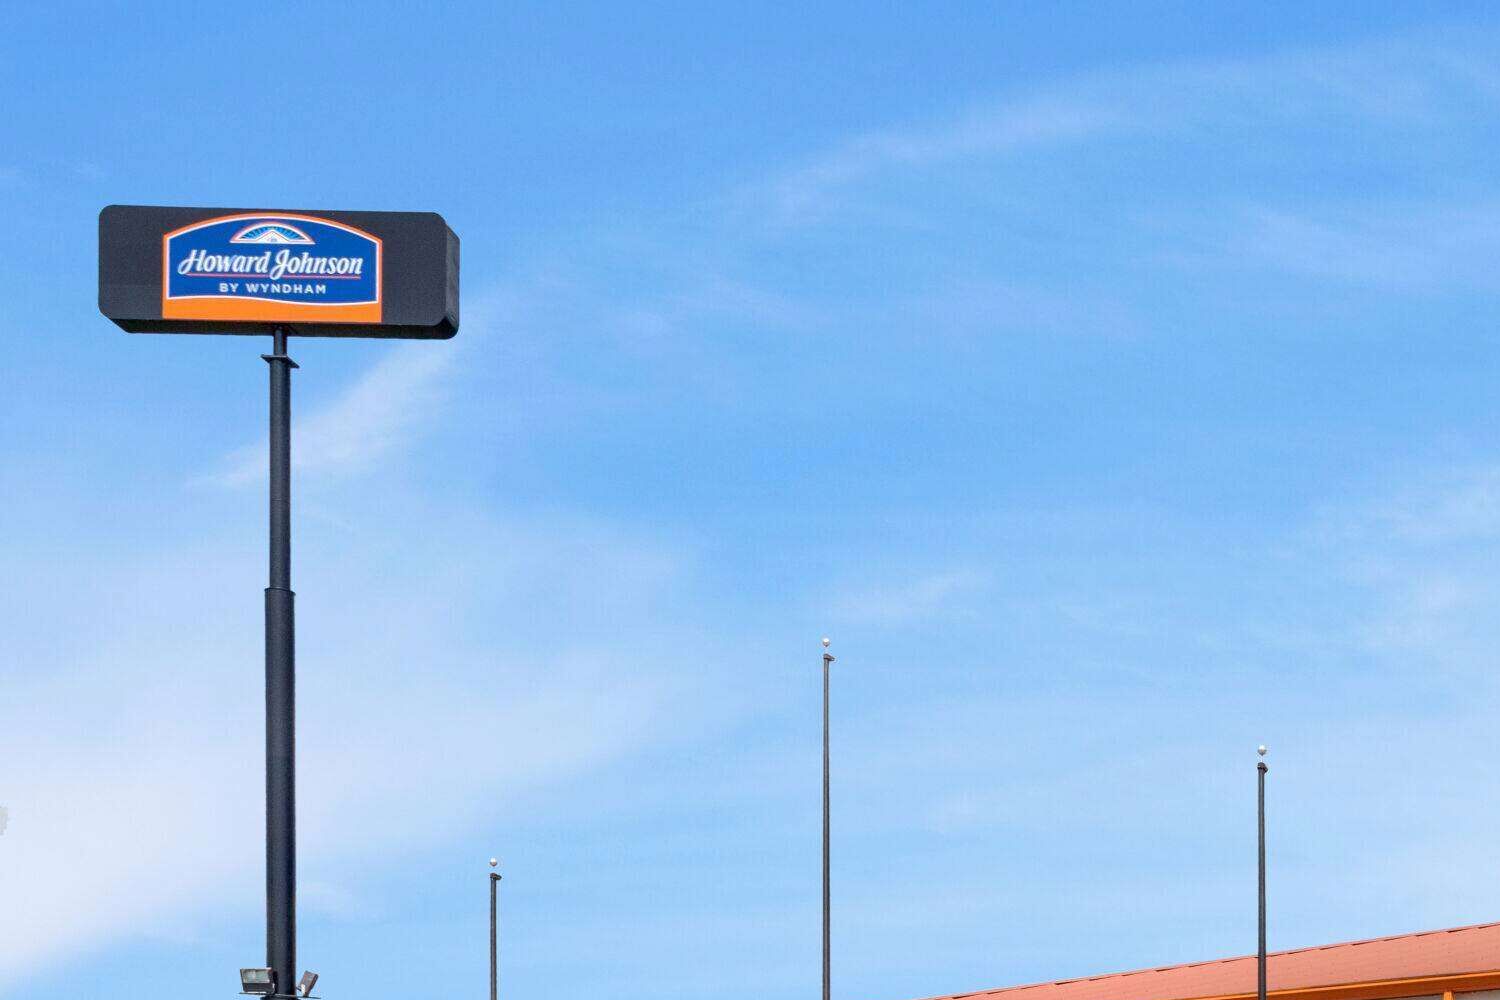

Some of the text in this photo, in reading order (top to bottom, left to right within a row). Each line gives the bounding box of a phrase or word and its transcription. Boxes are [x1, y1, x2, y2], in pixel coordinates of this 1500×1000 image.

[177, 249, 364, 280] Howard Johnson
[218, 282, 327, 294] BY WYNDHAM
